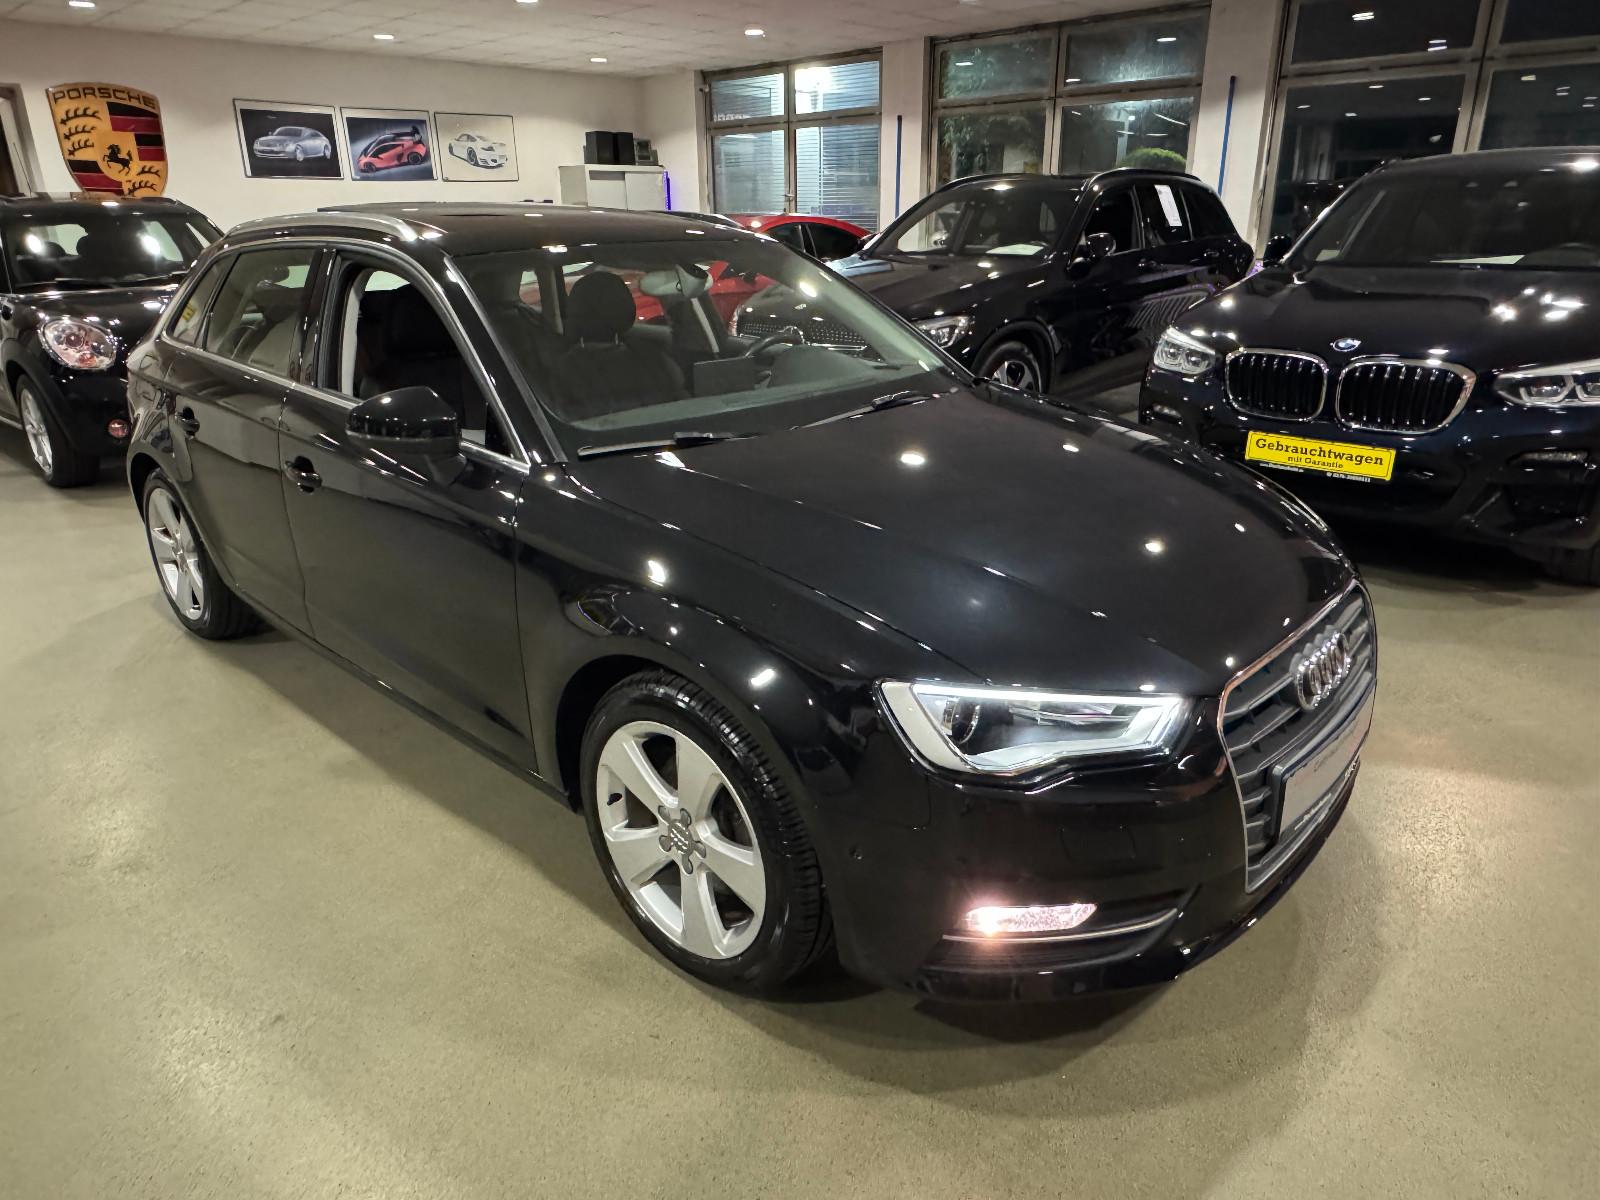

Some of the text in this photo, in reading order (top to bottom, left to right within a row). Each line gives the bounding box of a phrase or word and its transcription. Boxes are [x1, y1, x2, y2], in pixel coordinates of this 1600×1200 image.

[53, 87, 156, 109] PORSCHE
[1256, 439, 1384, 465] Gebrauchtwagen
[1287, 455, 1302, 463] mit
[1304, 457, 1344, 469] Garantie
